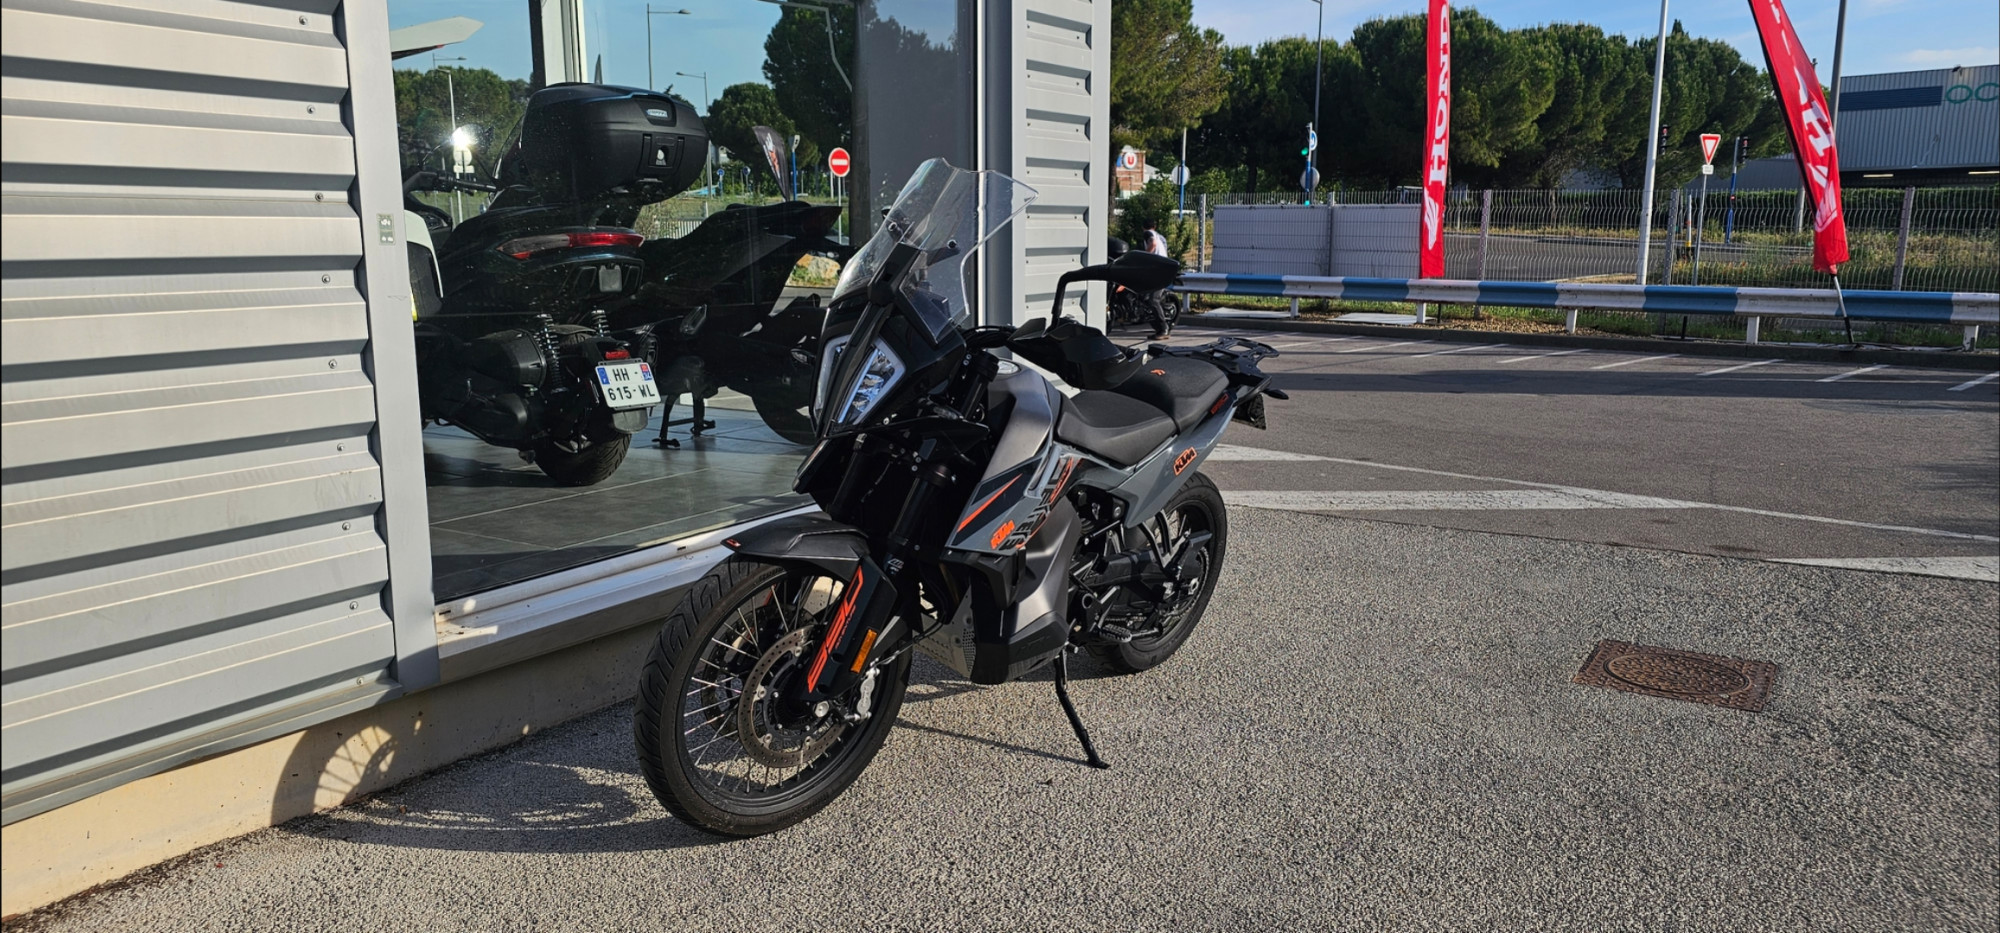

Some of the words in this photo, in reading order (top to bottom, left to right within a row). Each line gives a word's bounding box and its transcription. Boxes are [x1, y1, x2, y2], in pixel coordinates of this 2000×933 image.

[612, 367, 630, 382] HH
[607, 384, 656, 401] 615-WL
[1174, 447, 1197, 475] KTM
